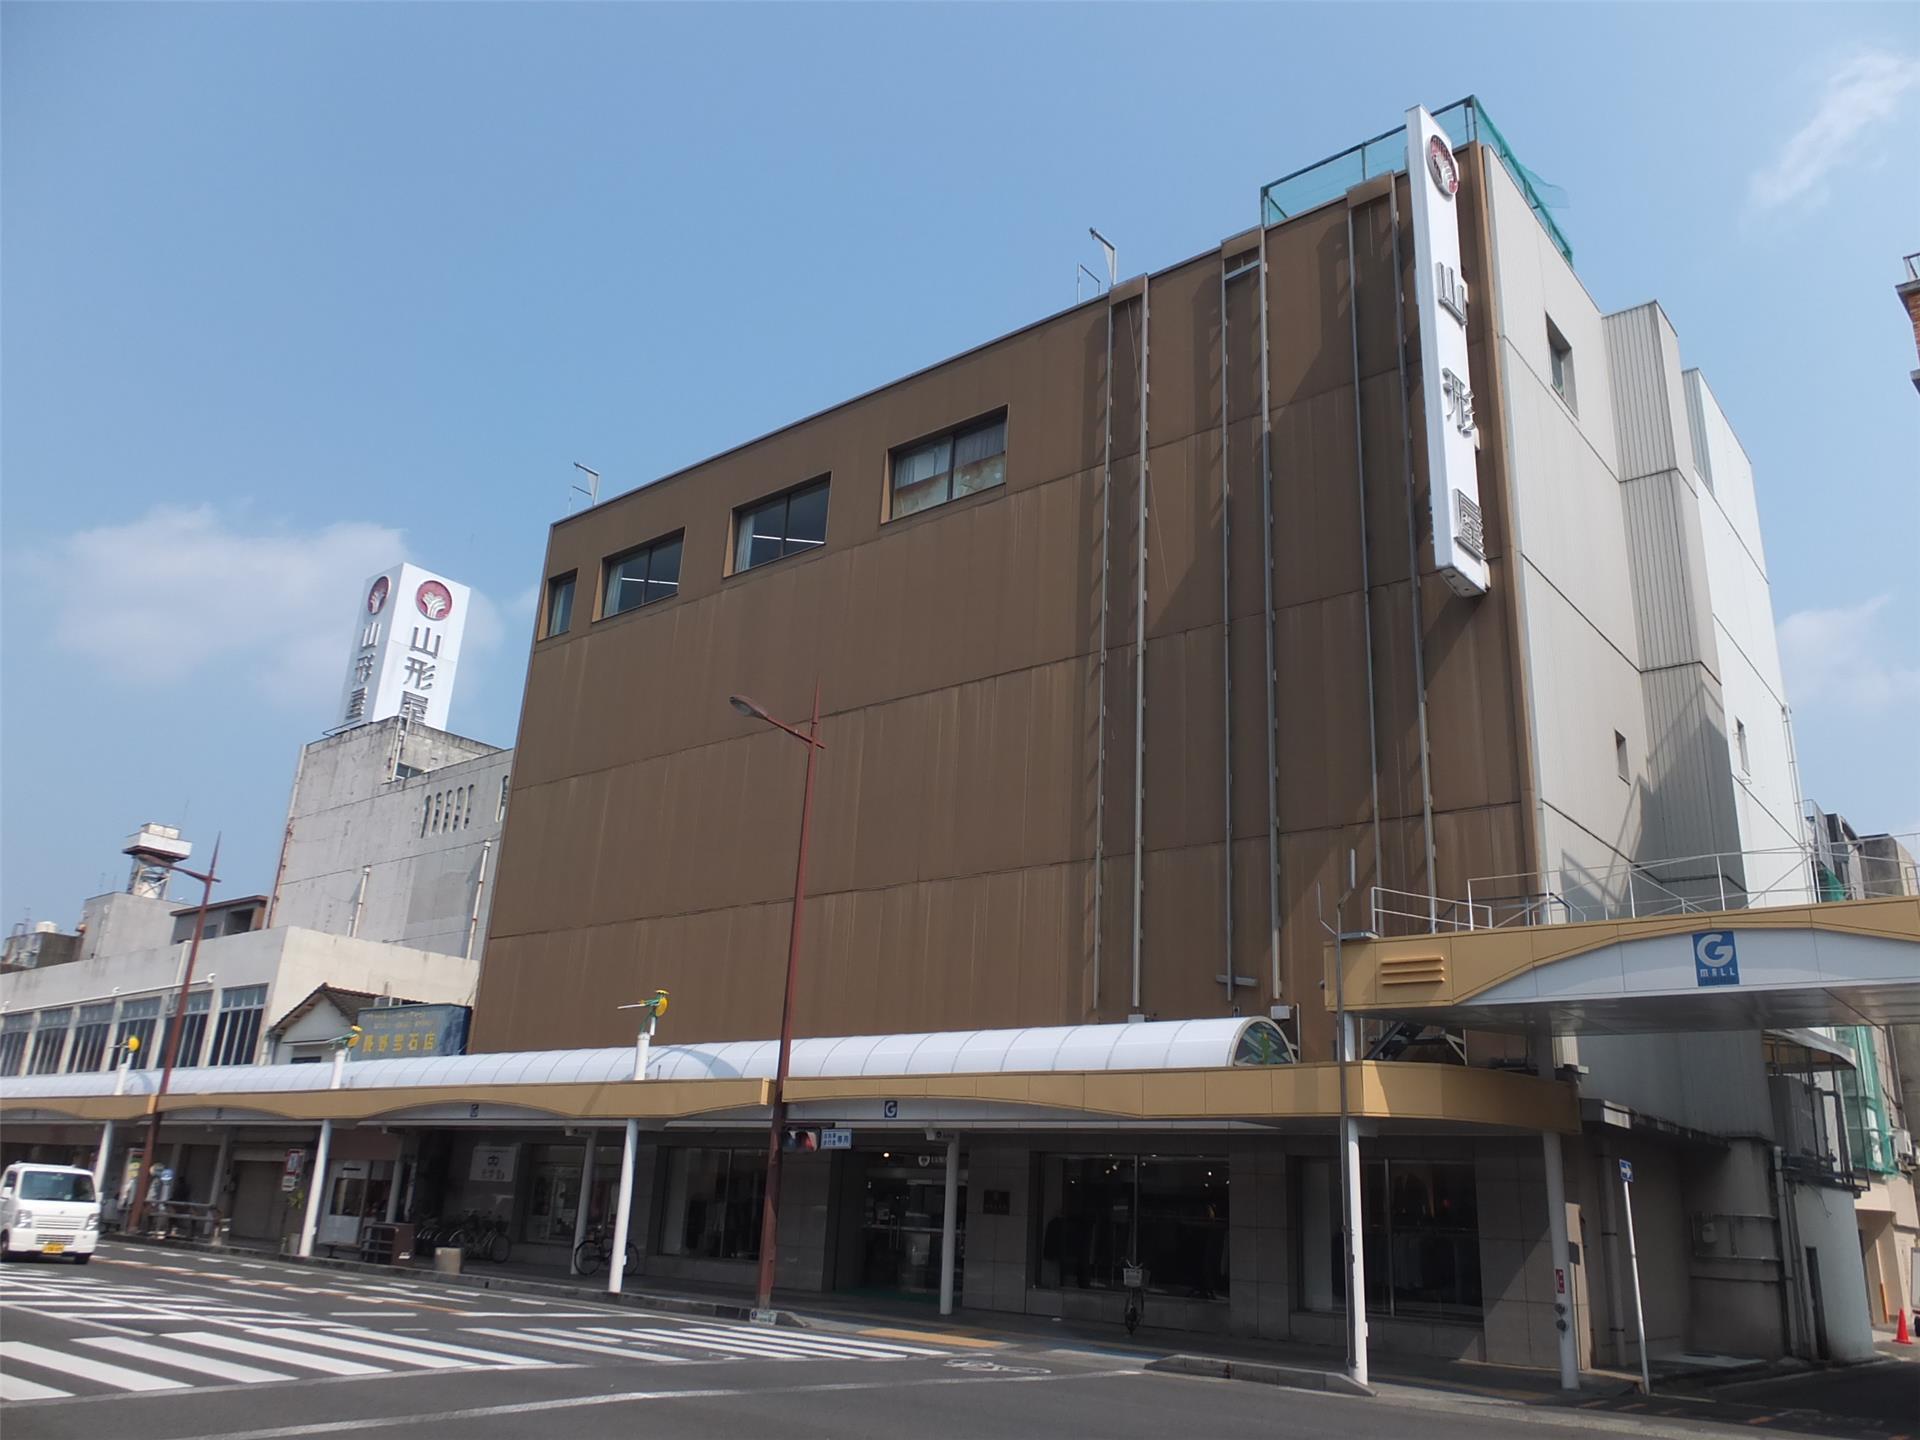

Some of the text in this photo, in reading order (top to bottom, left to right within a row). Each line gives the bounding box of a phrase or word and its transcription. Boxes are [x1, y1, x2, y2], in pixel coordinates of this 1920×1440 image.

[1435, 262, 1487, 558] 山形屋
[344, 621, 381, 720] 山形屋
[401, 627, 442, 725] 山形屋
[1696, 933, 1734, 968] G
[885, 1101, 897, 1117] G
